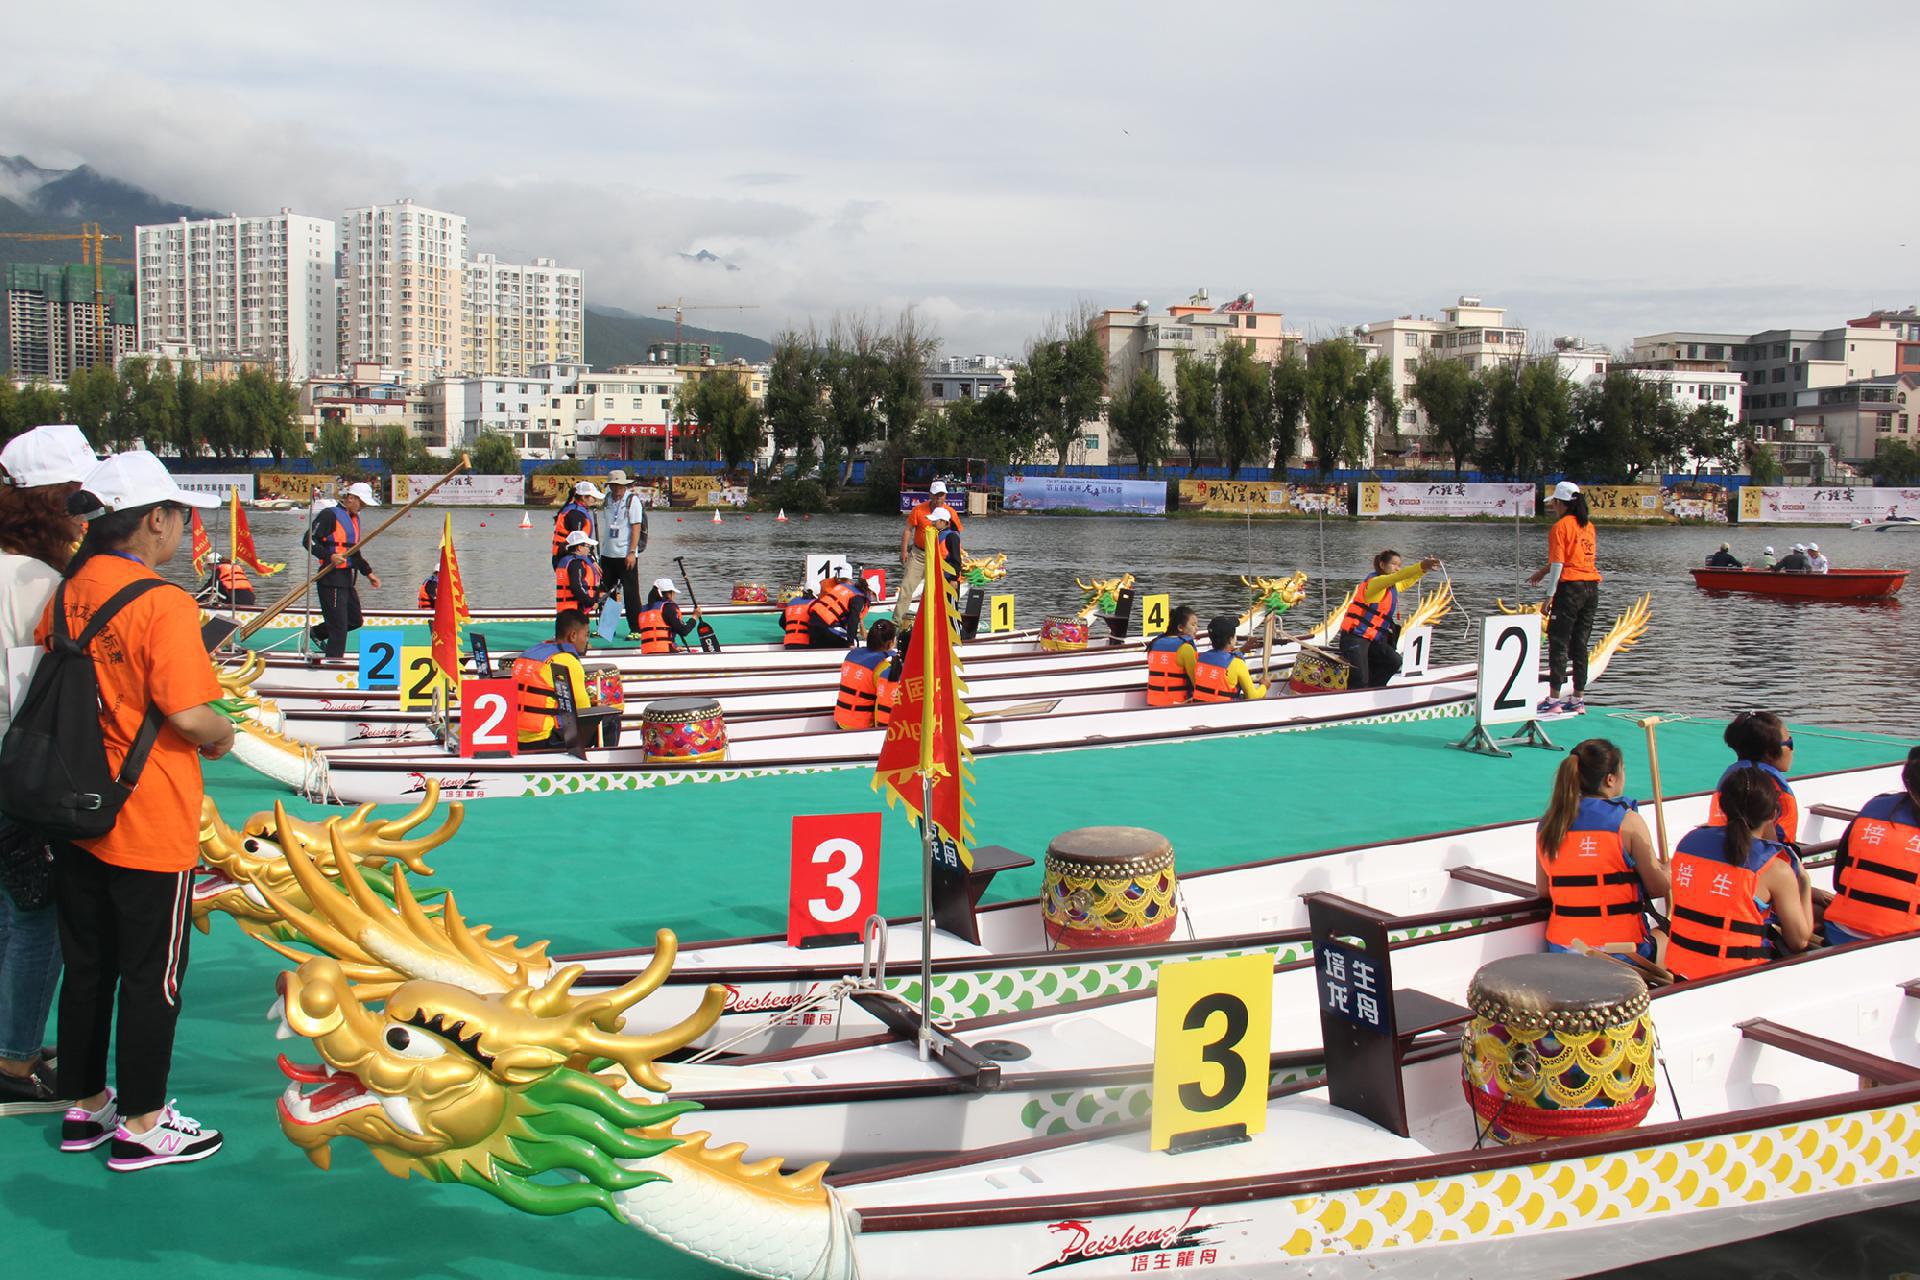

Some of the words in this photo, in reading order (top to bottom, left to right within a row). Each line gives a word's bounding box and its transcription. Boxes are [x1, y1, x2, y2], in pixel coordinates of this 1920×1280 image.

[998, 602, 1008, 626] 1
[1147, 602, 1165, 628] 4
[368, 642, 395, 680] 2
[1412, 635, 1423, 666] 1
[1493, 626, 1528, 711] 2
[409, 657, 438, 700] 2
[472, 693, 508, 745] 2
[808, 837, 863, 923] 3
[1676, 862, 1734, 897] 培生
[1323, 948, 1377, 994] 培生
[1327, 981, 1379, 1025] 龙舟
[1178, 992, 1249, 1113] 3
[1131, 1249, 1218, 1272] 培生龍舟
